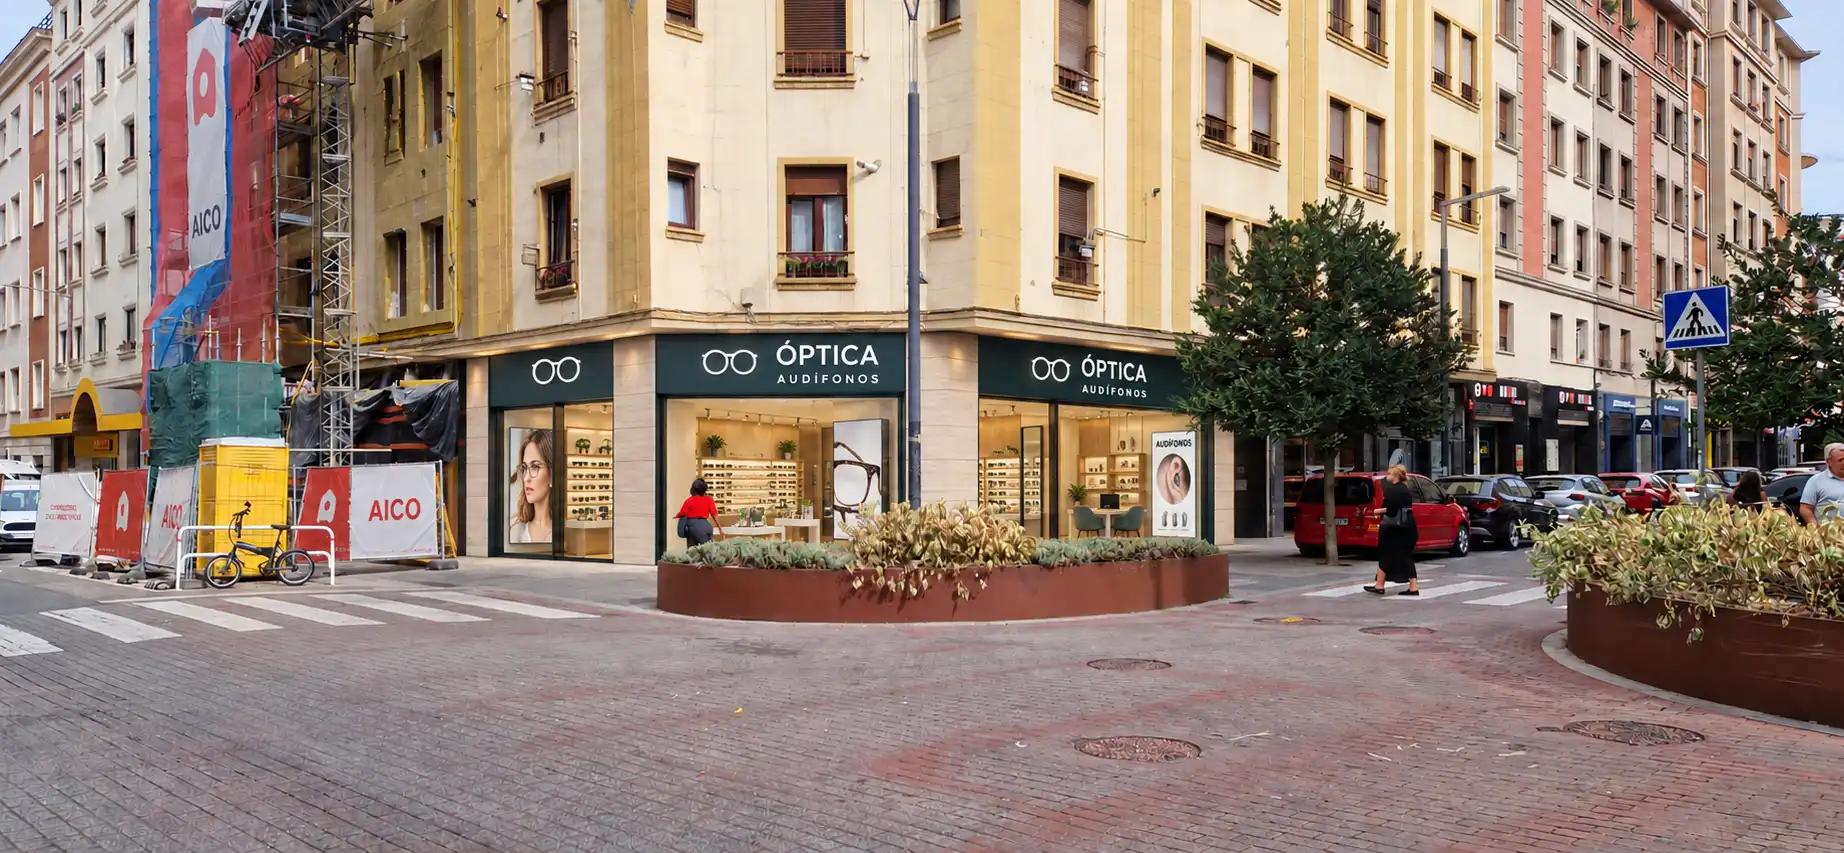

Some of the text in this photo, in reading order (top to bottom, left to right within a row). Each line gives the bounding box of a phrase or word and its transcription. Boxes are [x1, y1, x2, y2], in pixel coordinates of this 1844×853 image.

[191, 204, 221, 239] AICO
[776, 340, 879, 366] ÓPTICA
[777, 372, 879, 384] AUDÍFONOS
[1081, 353, 1147, 383] ÓPTICA
[1081, 384, 1147, 398] AUDÍFONOS
[161, 503, 184, 529] AICO
[368, 497, 421, 522] AICO
